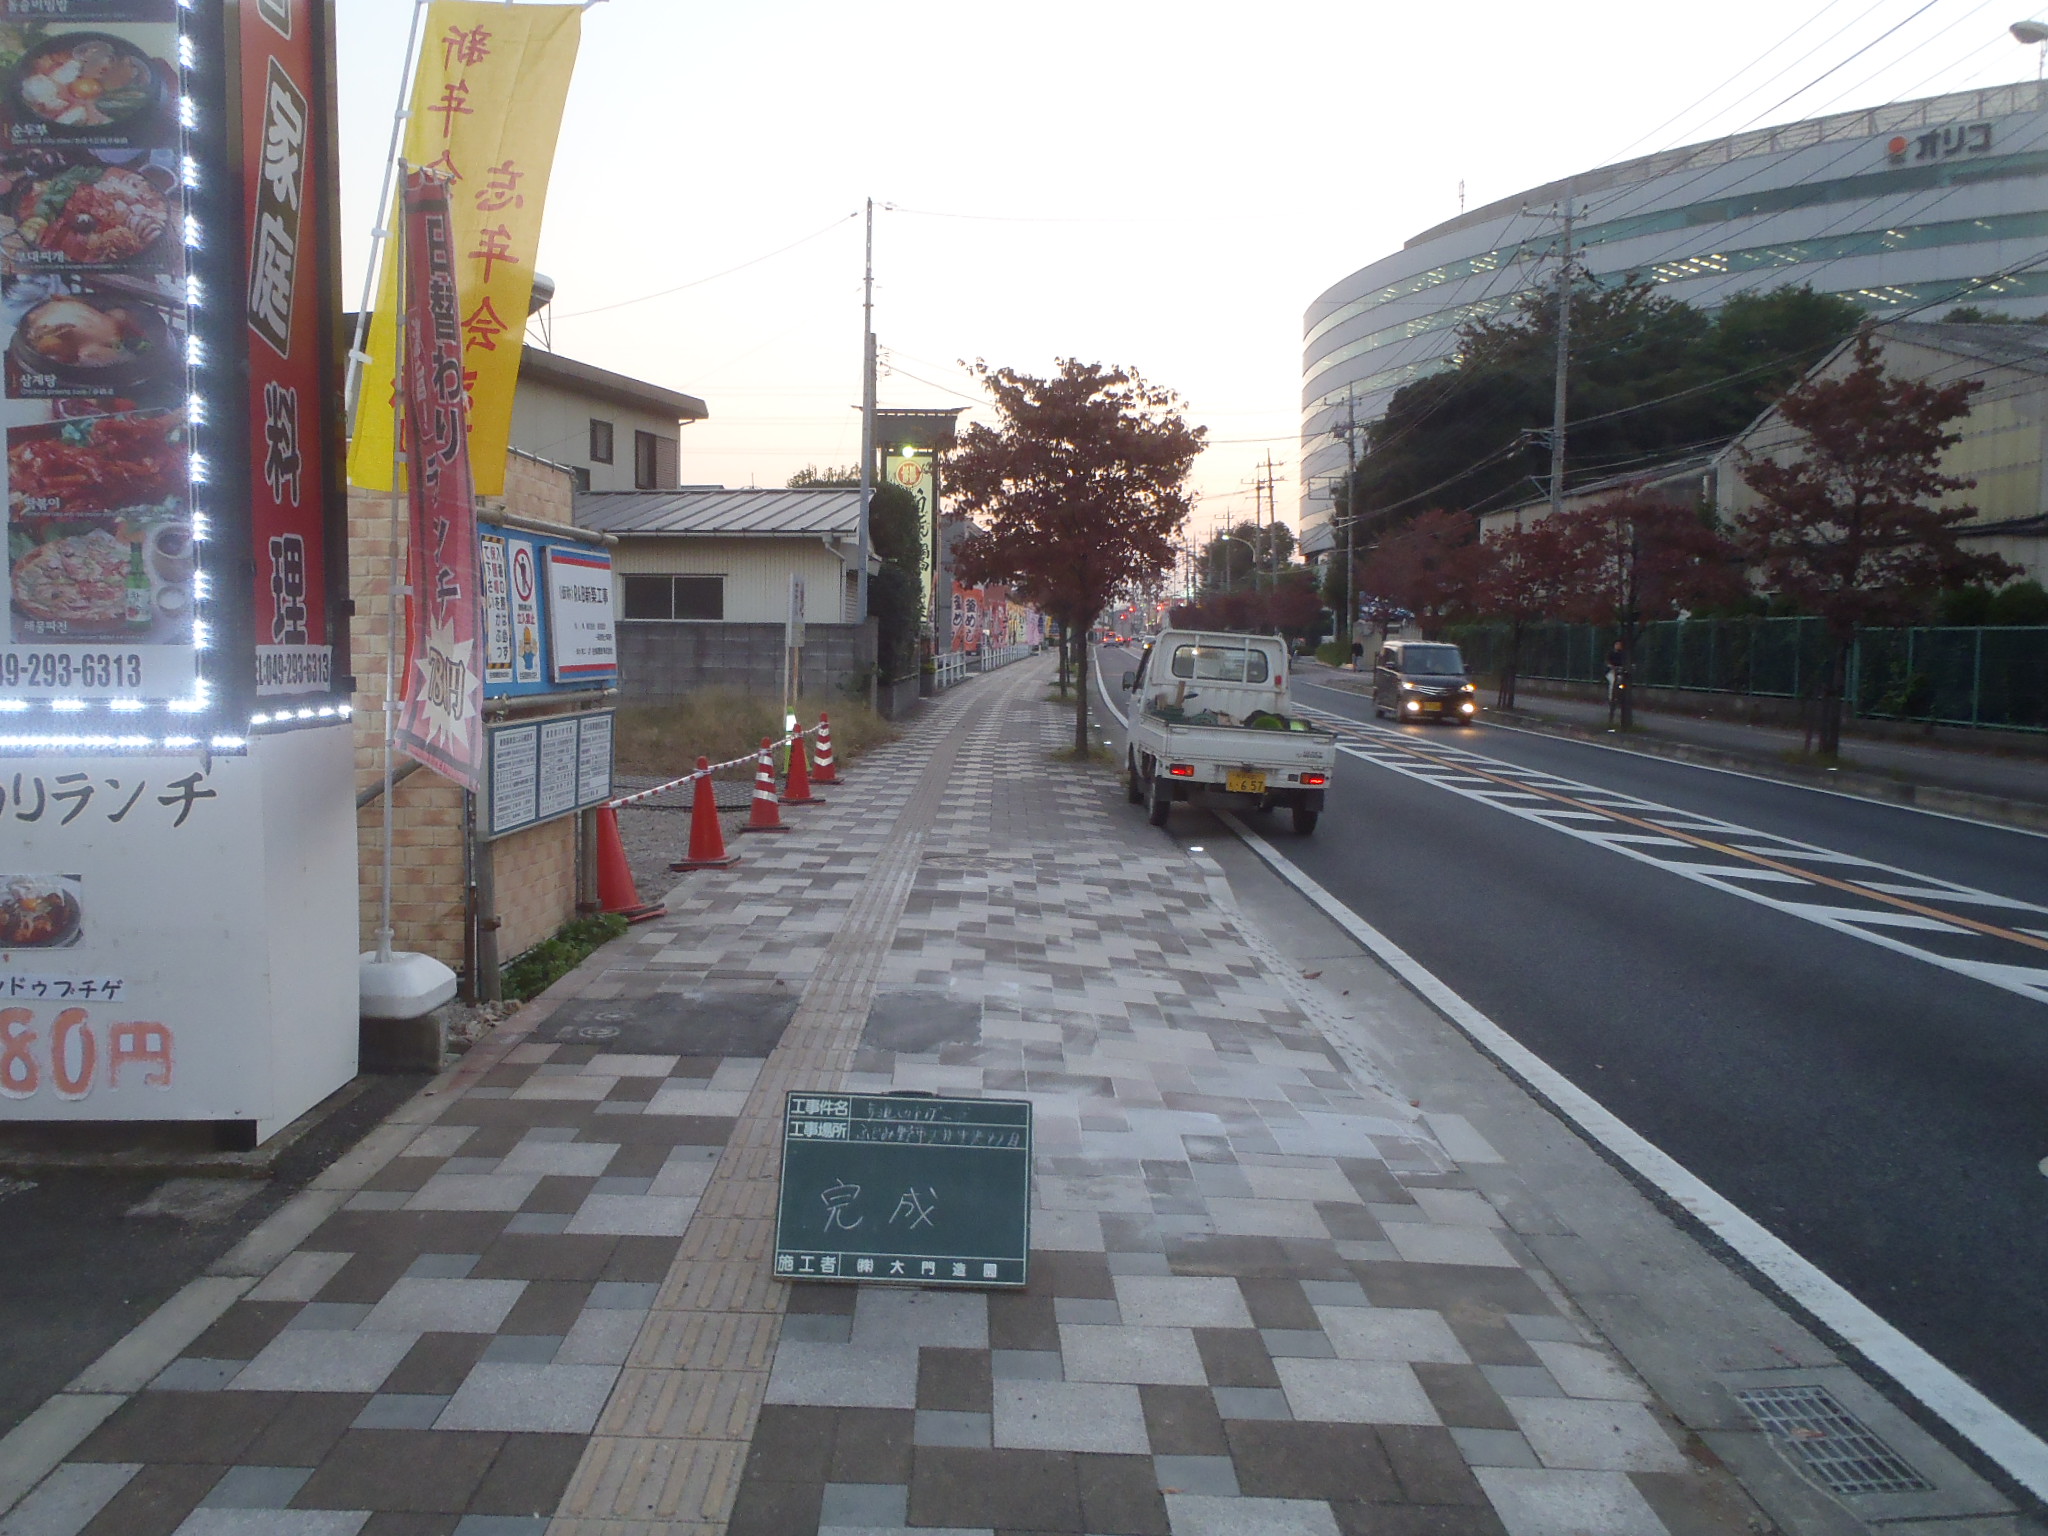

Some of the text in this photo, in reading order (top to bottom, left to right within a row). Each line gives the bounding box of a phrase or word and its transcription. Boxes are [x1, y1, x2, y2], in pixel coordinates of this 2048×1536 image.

[1916, 123, 1992, 161] オリコ
[965, 598, 977, 643] 釜めし
[0, 652, 141, 687] 9-293-6313
[256, 653, 329, 686] L:049-293-6313
[0, 772, 217, 828] りランチ
[791, 1099, 848, 1116] 工事件名
[789, 1121, 847, 1139] 工事場所
[778, 1254, 836, 1273] 施工者
